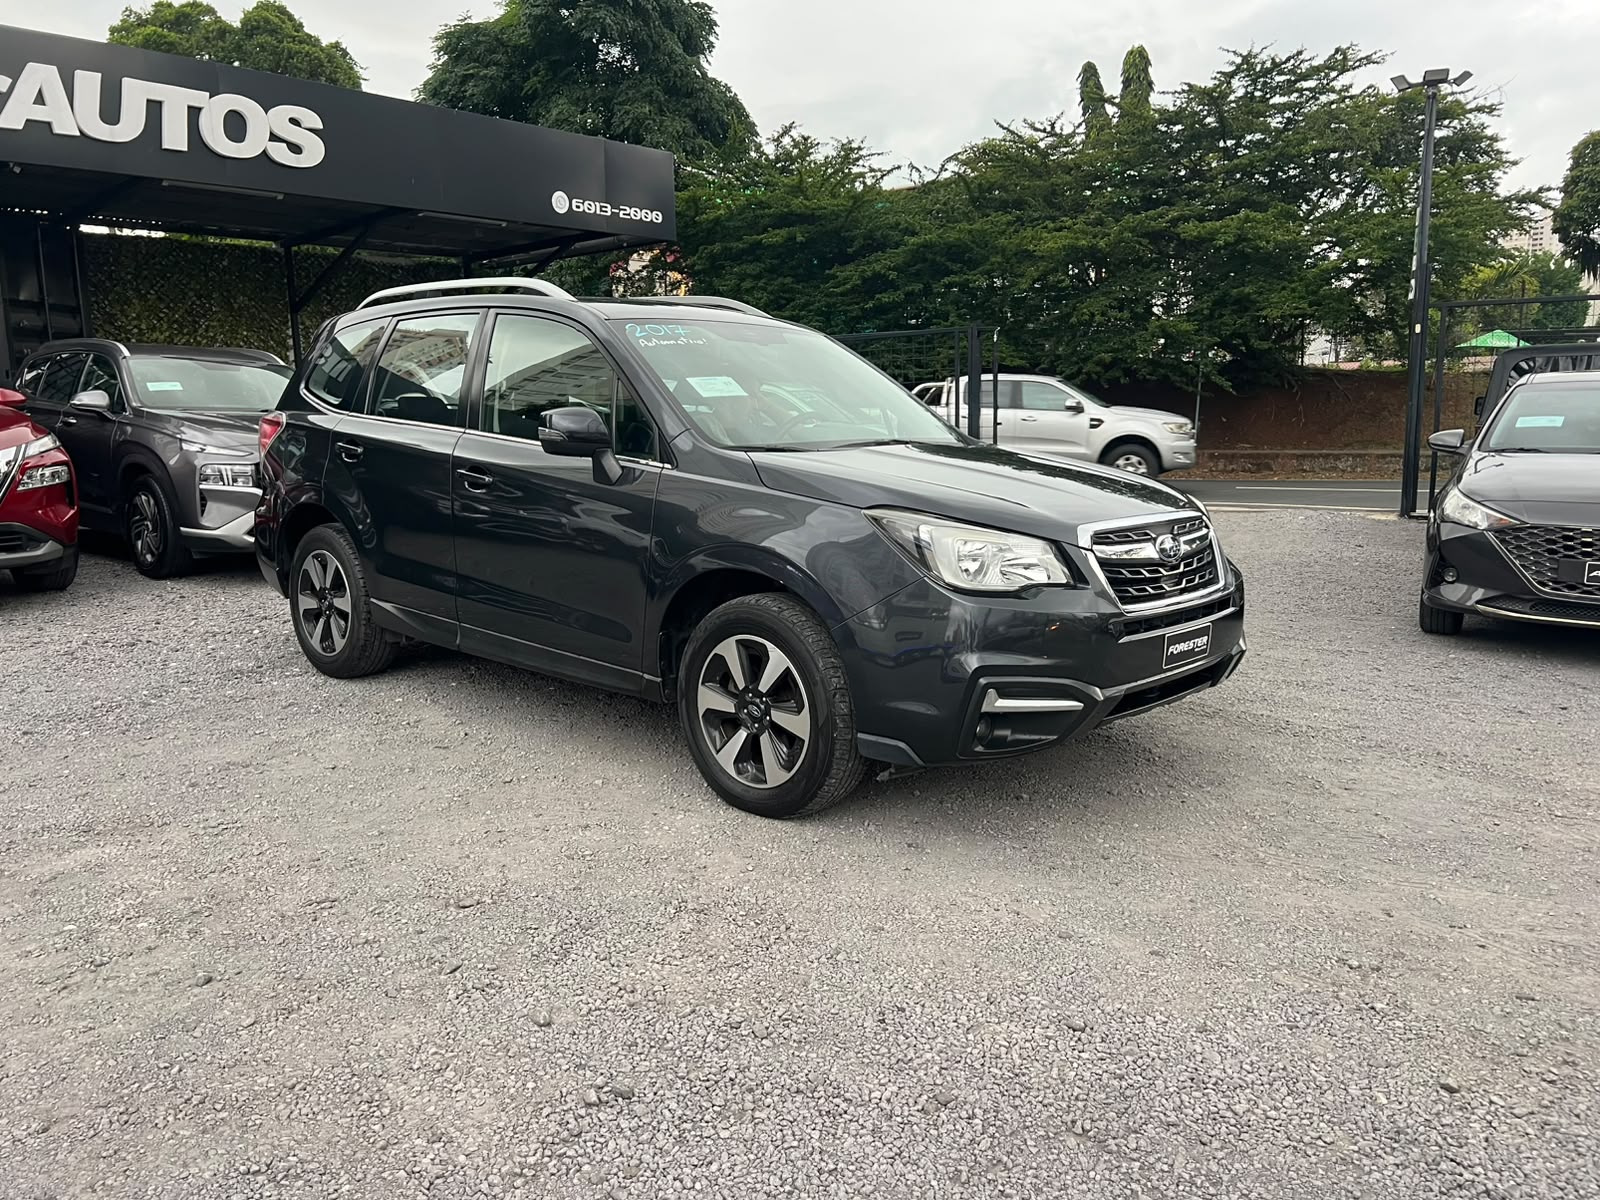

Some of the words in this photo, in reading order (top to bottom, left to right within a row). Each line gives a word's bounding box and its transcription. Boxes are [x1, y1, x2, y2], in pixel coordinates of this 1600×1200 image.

[571, 198, 662, 223] 6013-2000
[625, 323, 691, 337] 2017
[1167, 635, 1208, 656] FORESTER
